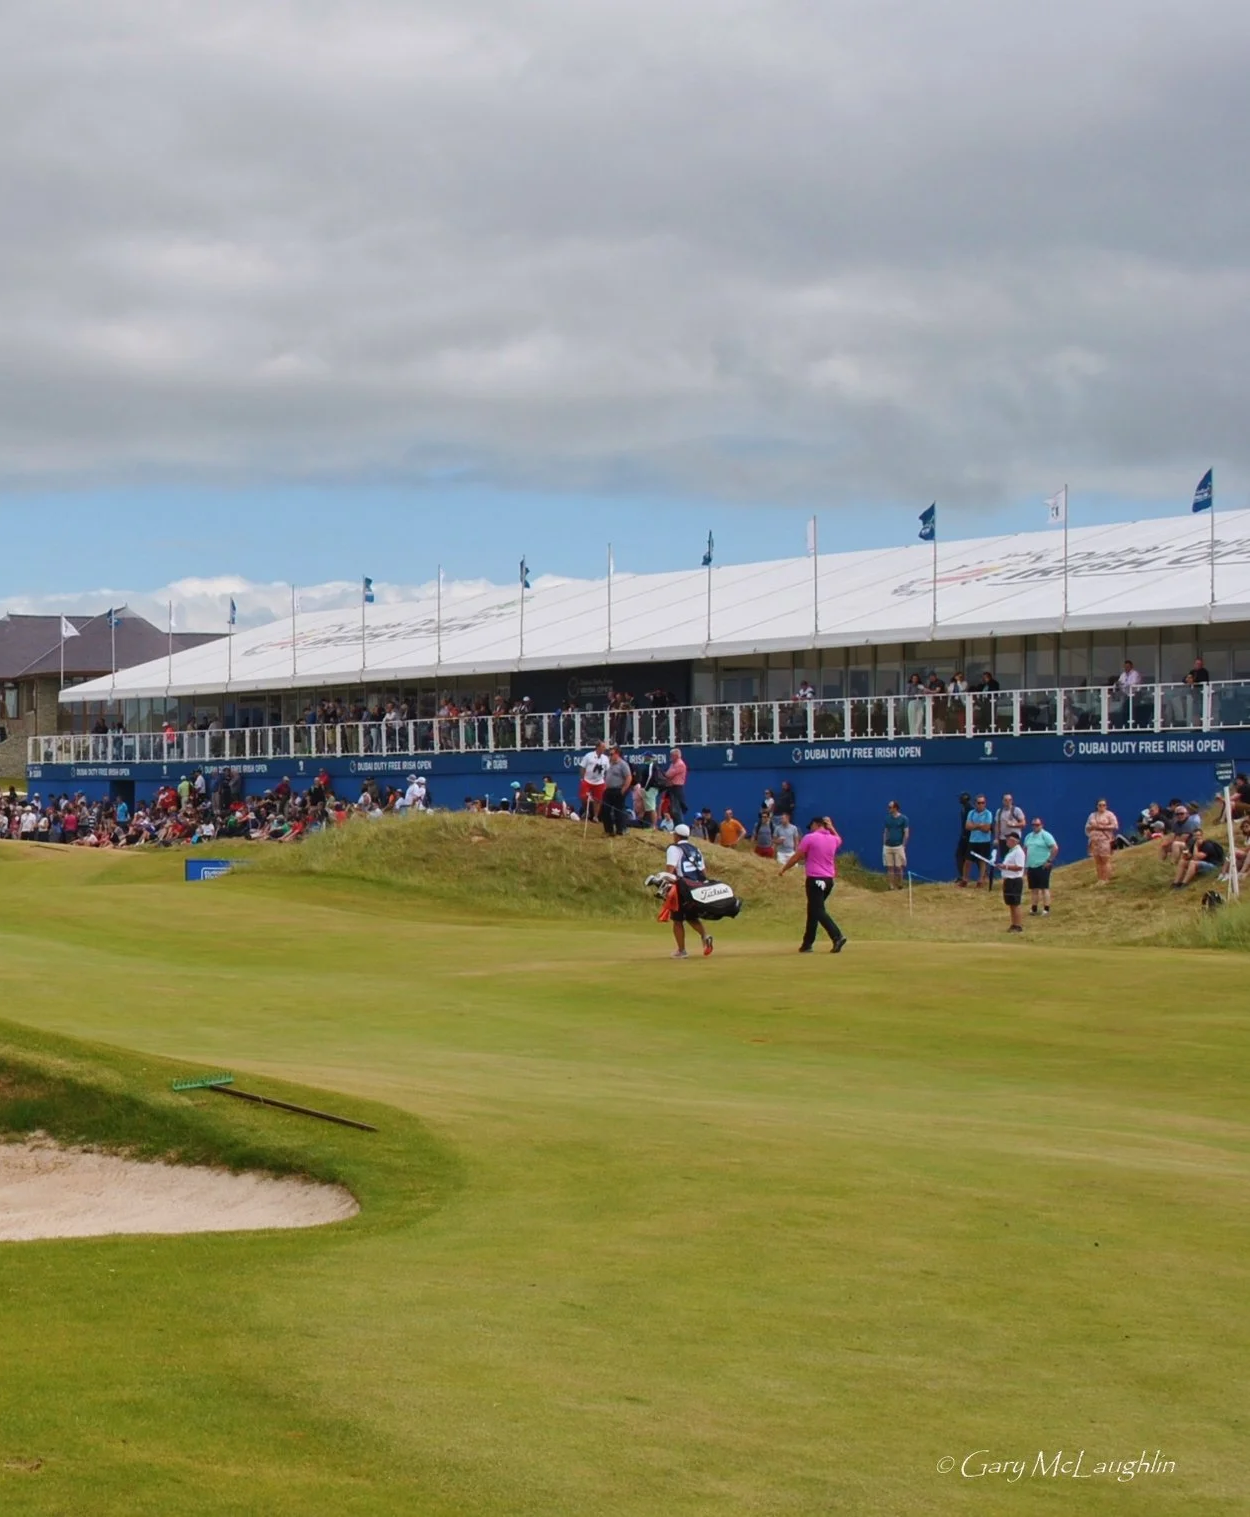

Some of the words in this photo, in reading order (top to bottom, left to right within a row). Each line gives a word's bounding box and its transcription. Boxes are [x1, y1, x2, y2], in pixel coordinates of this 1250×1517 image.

[804, 748, 829, 760] DUBAI
[830, 748, 851, 759] DUTY
[852, 748, 874, 759] FREE
[875, 747, 898, 758] IRISH
[899, 746, 921, 758] OPEN
[1078, 742, 1108, 754] DUBAI
[1110, 742, 1137, 754] DUTY
[1138, 741, 1165, 753] FREE
[1166, 740, 1195, 753] IRISH
[1196, 740, 1225, 752] OPEN
[357, 762, 373, 771] DUBAI
[374, 761, 388, 770] DUTY
[388, 761, 401, 770] FREE
[402, 761, 417, 770] IRISH
[417, 760, 432, 770] OPEN
